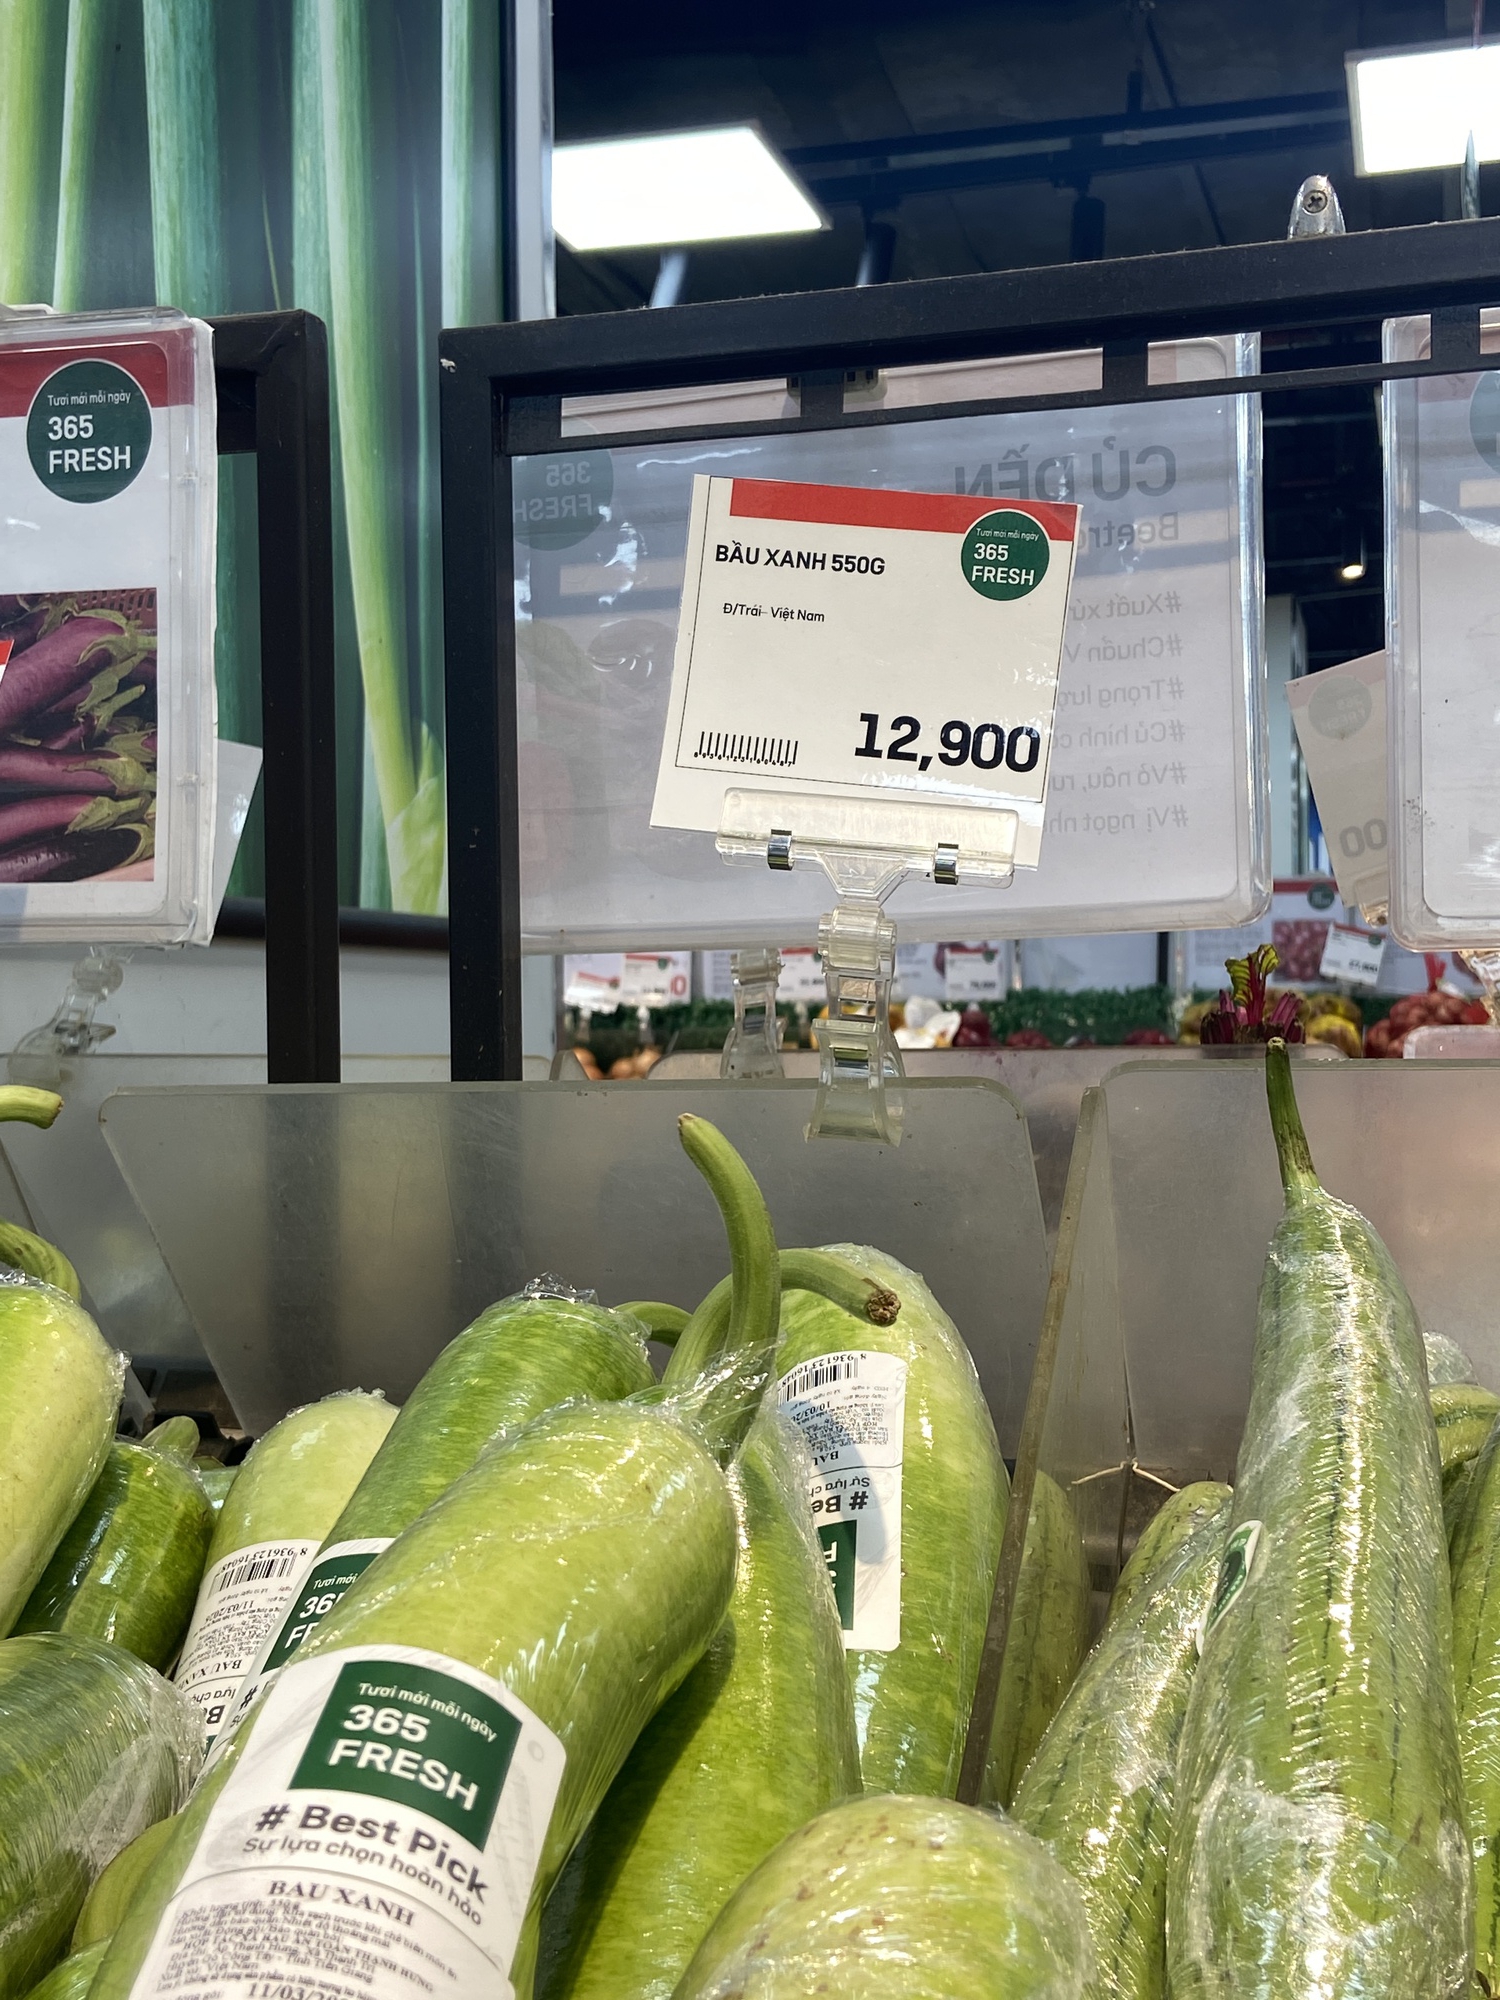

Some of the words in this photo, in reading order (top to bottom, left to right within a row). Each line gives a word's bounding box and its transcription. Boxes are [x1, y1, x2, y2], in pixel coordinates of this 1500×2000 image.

[47, 393, 69, 406] Tươi
[71, 392, 88, 405] mới
[89, 390, 106, 404] mỗi
[107, 389, 131, 404] ngày
[48, 414, 94, 441] 365
[49, 445, 131, 474] FRESH
[715, 540, 760, 564] BẦU
[764, 548, 827, 571] XANH
[831, 554, 886, 575] 550G
[973, 543, 1009, 561] 365
[972, 565, 1034, 585] FRESH
[771, 606, 795, 621] Việt
[797, 609, 825, 622] Nam
[854, 712, 1041, 773] 12,900
[825, 1477, 847, 1491] lựa
[850, 1476, 870, 1488] Sự
[811, 1494, 841, 1514] Be
[252, 1549, 294, 1561] 936123
[300, 1547, 308, 1556] 8
[313, 1574, 335, 1590] Tươi
[343, 1704, 431, 1743] 365
[359, 1682, 397, 1697] Tươi
[399, 1688, 430, 1708] mới
[431, 1697, 460, 1718] mỗi
[462, 1713, 497, 1743] ngày
[328, 1738, 479, 1812] FRESH
[255, 1803, 290, 1832] #
[300, 1805, 400, 1846] Best
[408, 1827, 489, 1904] Pick
[243, 1836, 278, 1854] Sự
[281, 1836, 320, 1853] lựa
[326, 1841, 385, 1866] chọn
[390, 1855, 444, 1896] hoàn
[448, 1888, 482, 1926] hảo
[333, 1886, 416, 1927] XANH
